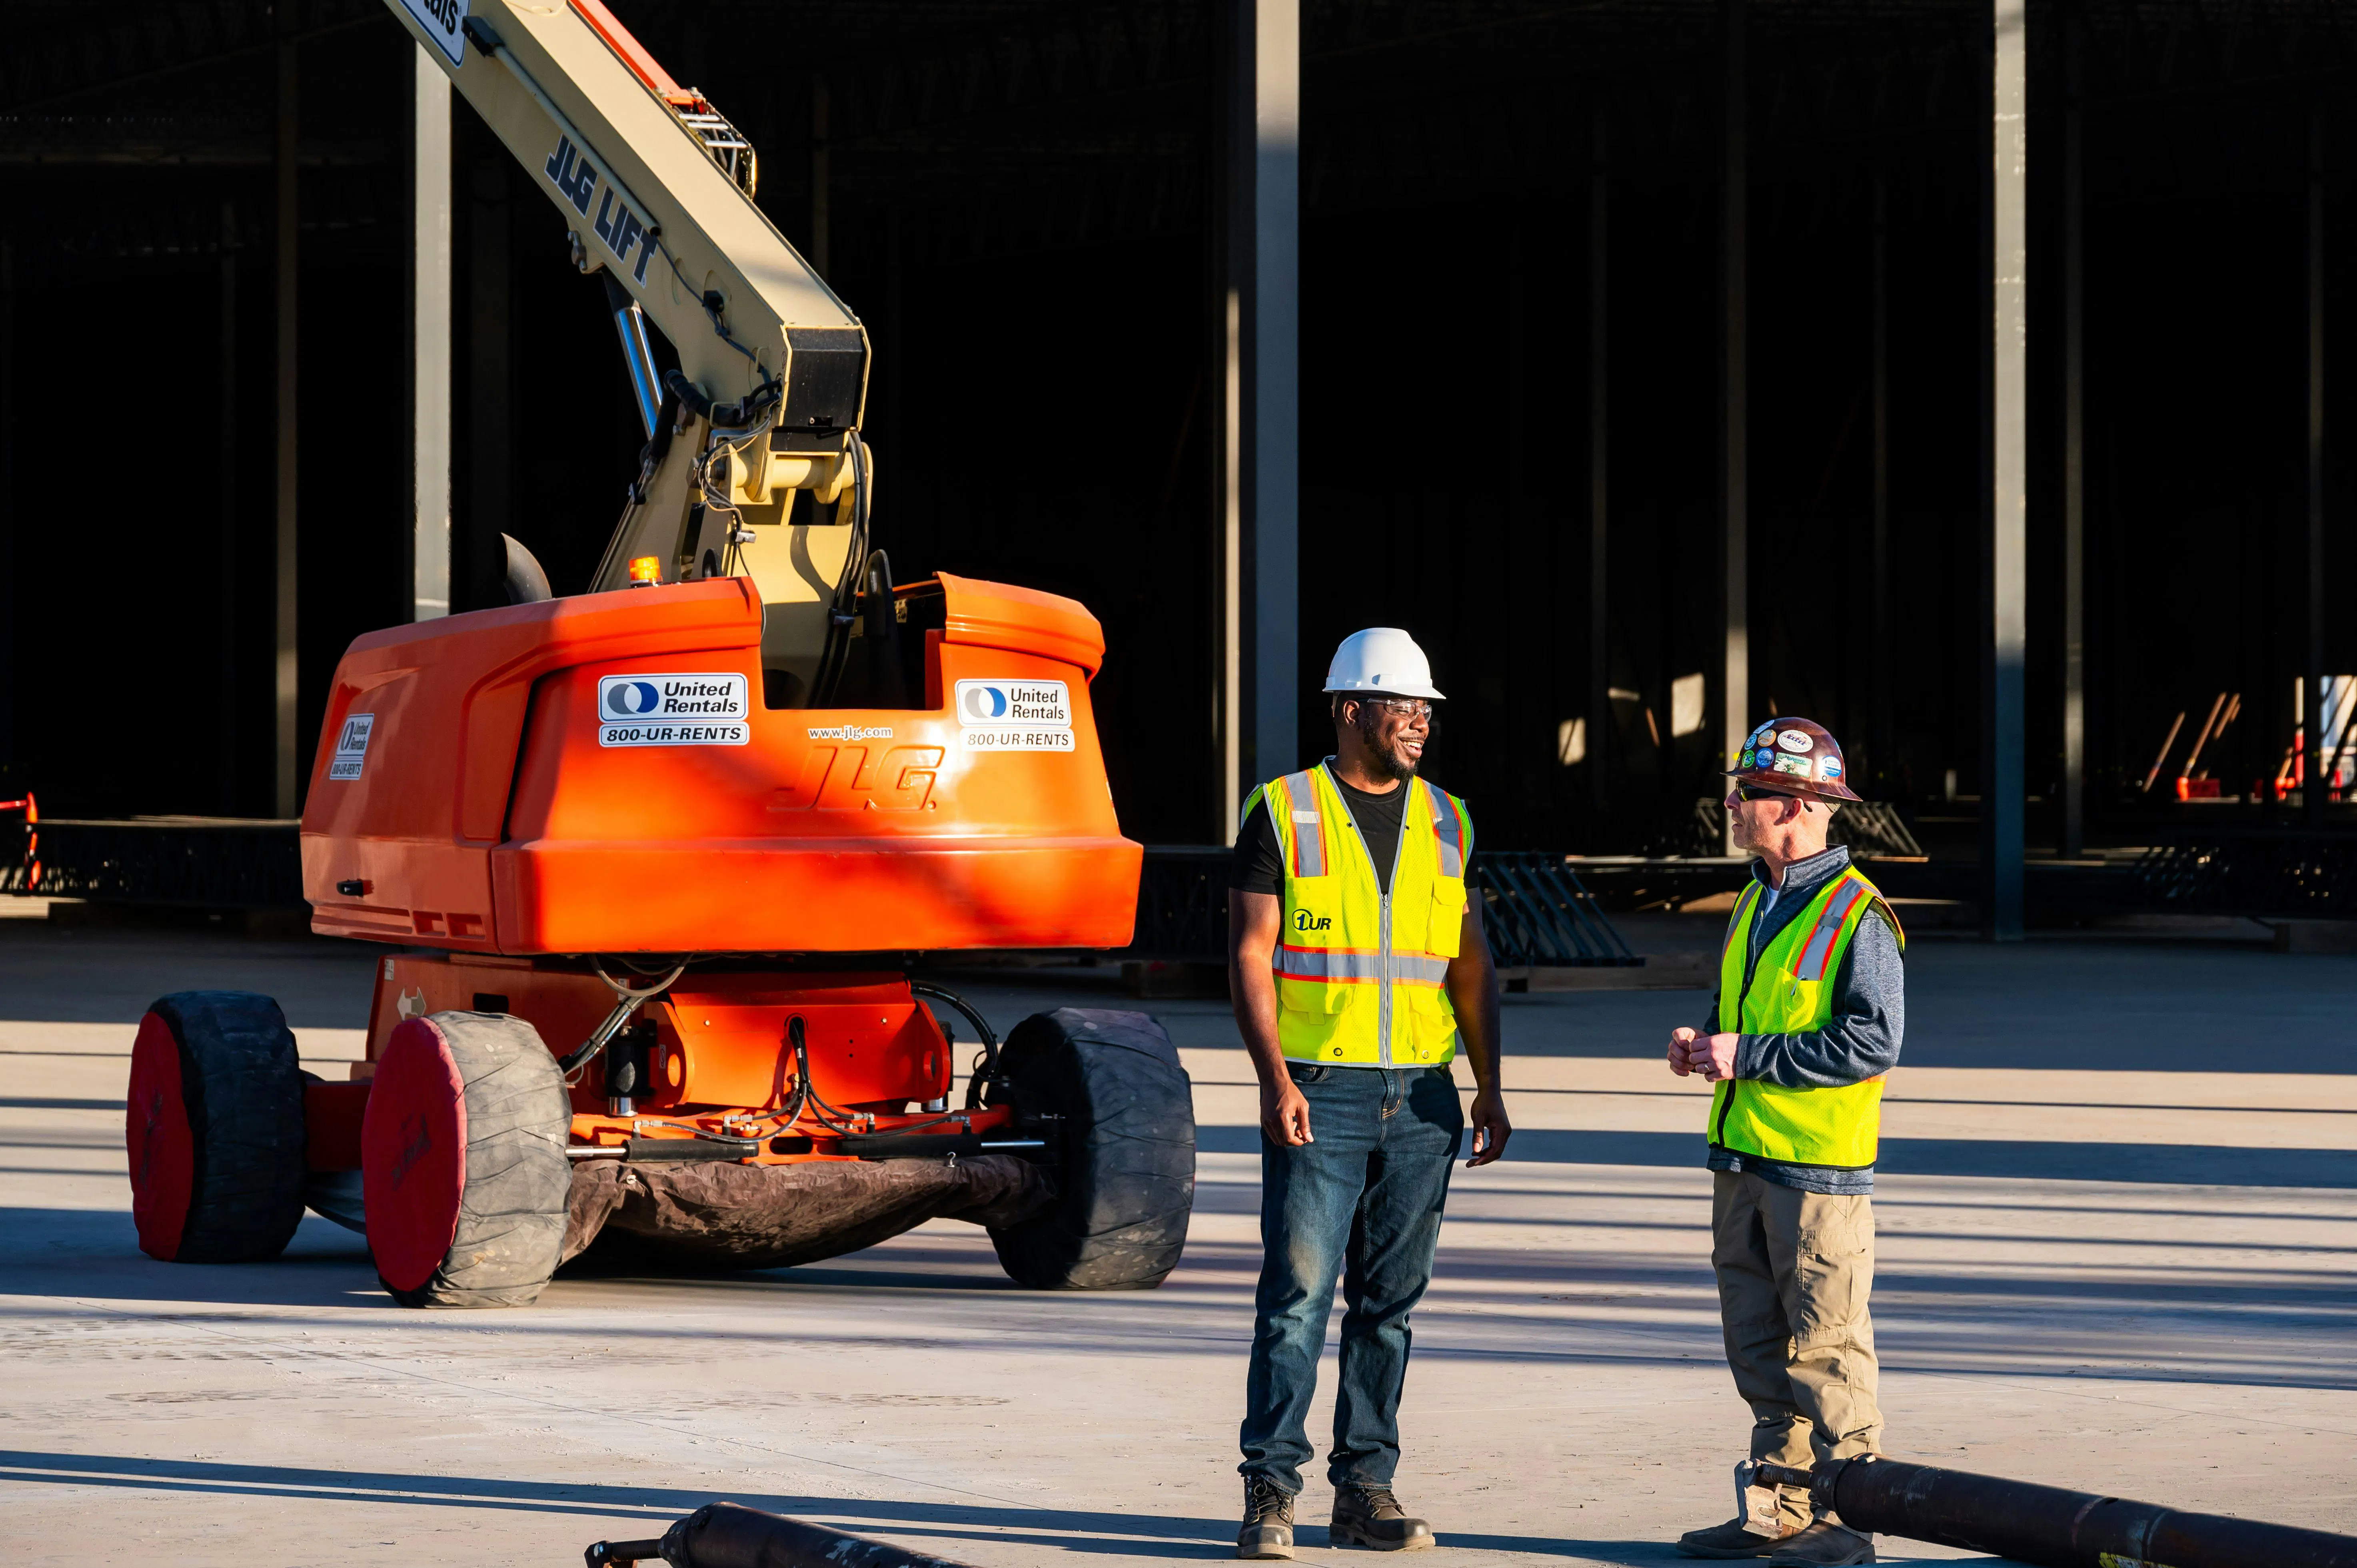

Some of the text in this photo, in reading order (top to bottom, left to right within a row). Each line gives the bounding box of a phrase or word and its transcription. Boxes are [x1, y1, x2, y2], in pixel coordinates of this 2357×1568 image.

[545, 134, 659, 284] JLG LIFT
[664, 682, 731, 696] United
[1011, 688, 1058, 703] United
[664, 698, 738, 713] Rentals
[1013, 705, 1064, 719] Rentals
[607, 727, 741, 742] 800-UR-RENTS
[809, 726, 892, 739] www.jlg.com
[967, 734, 1069, 746] 800-UR-RENTS
